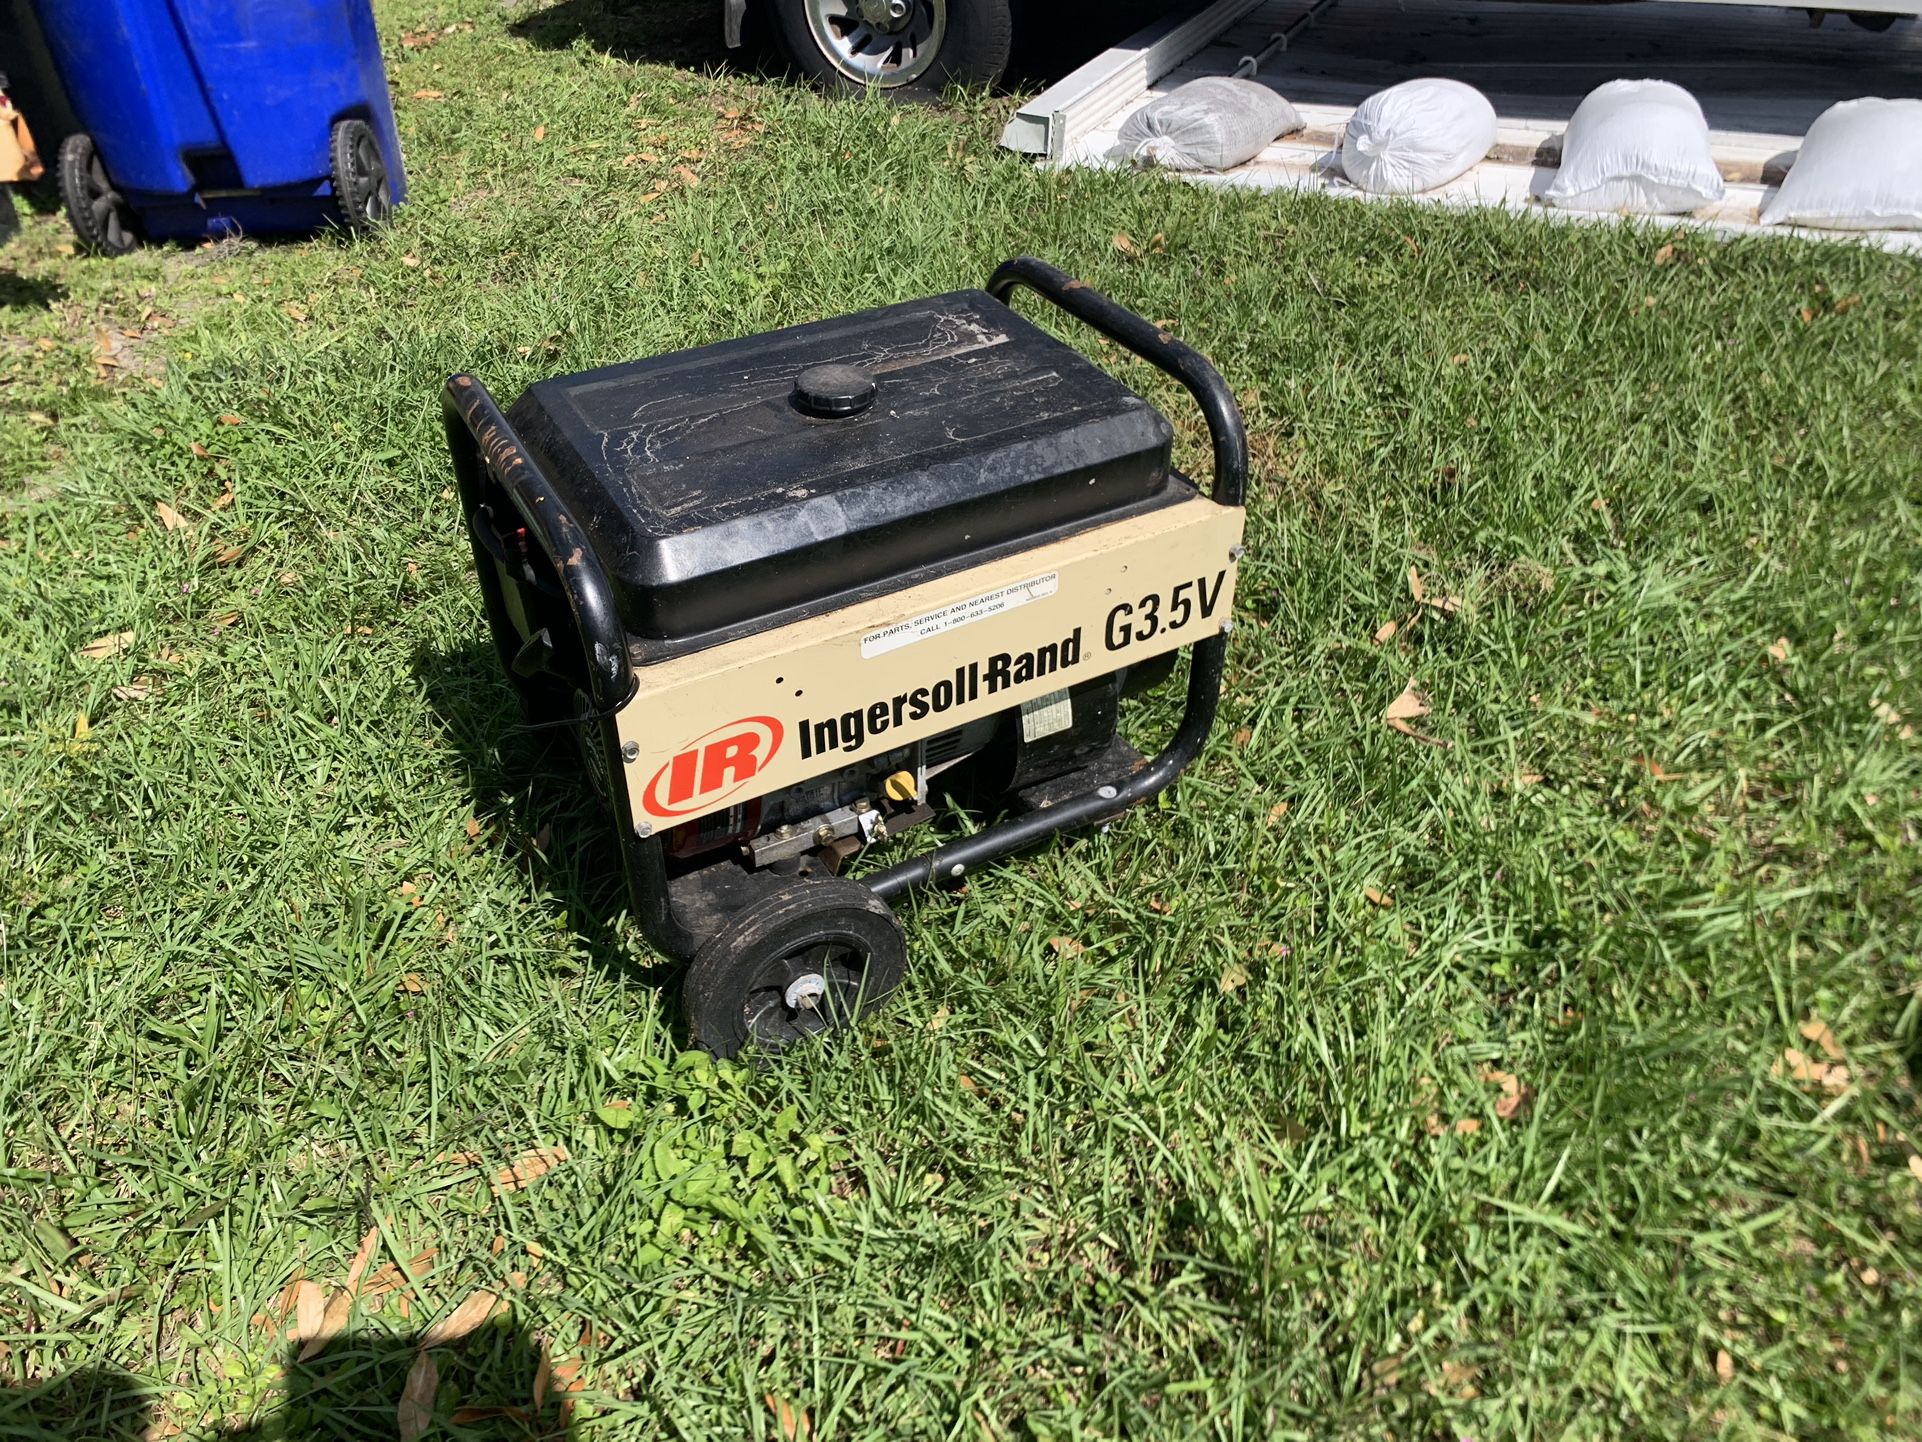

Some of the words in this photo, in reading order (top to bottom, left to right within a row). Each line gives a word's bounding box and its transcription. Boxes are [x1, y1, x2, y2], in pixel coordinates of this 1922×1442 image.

[863, 632, 881, 644] FOR
[914, 609, 948, 626] SERVICE
[950, 604, 967, 615] AND
[968, 590, 1005, 607] NEAREST
[1006, 573, 1056, 596] DISTRIBUTOR
[920, 624, 941, 636] CALL
[1104, 569, 1227, 651] G3.5V
[667, 731, 761, 806] IR
